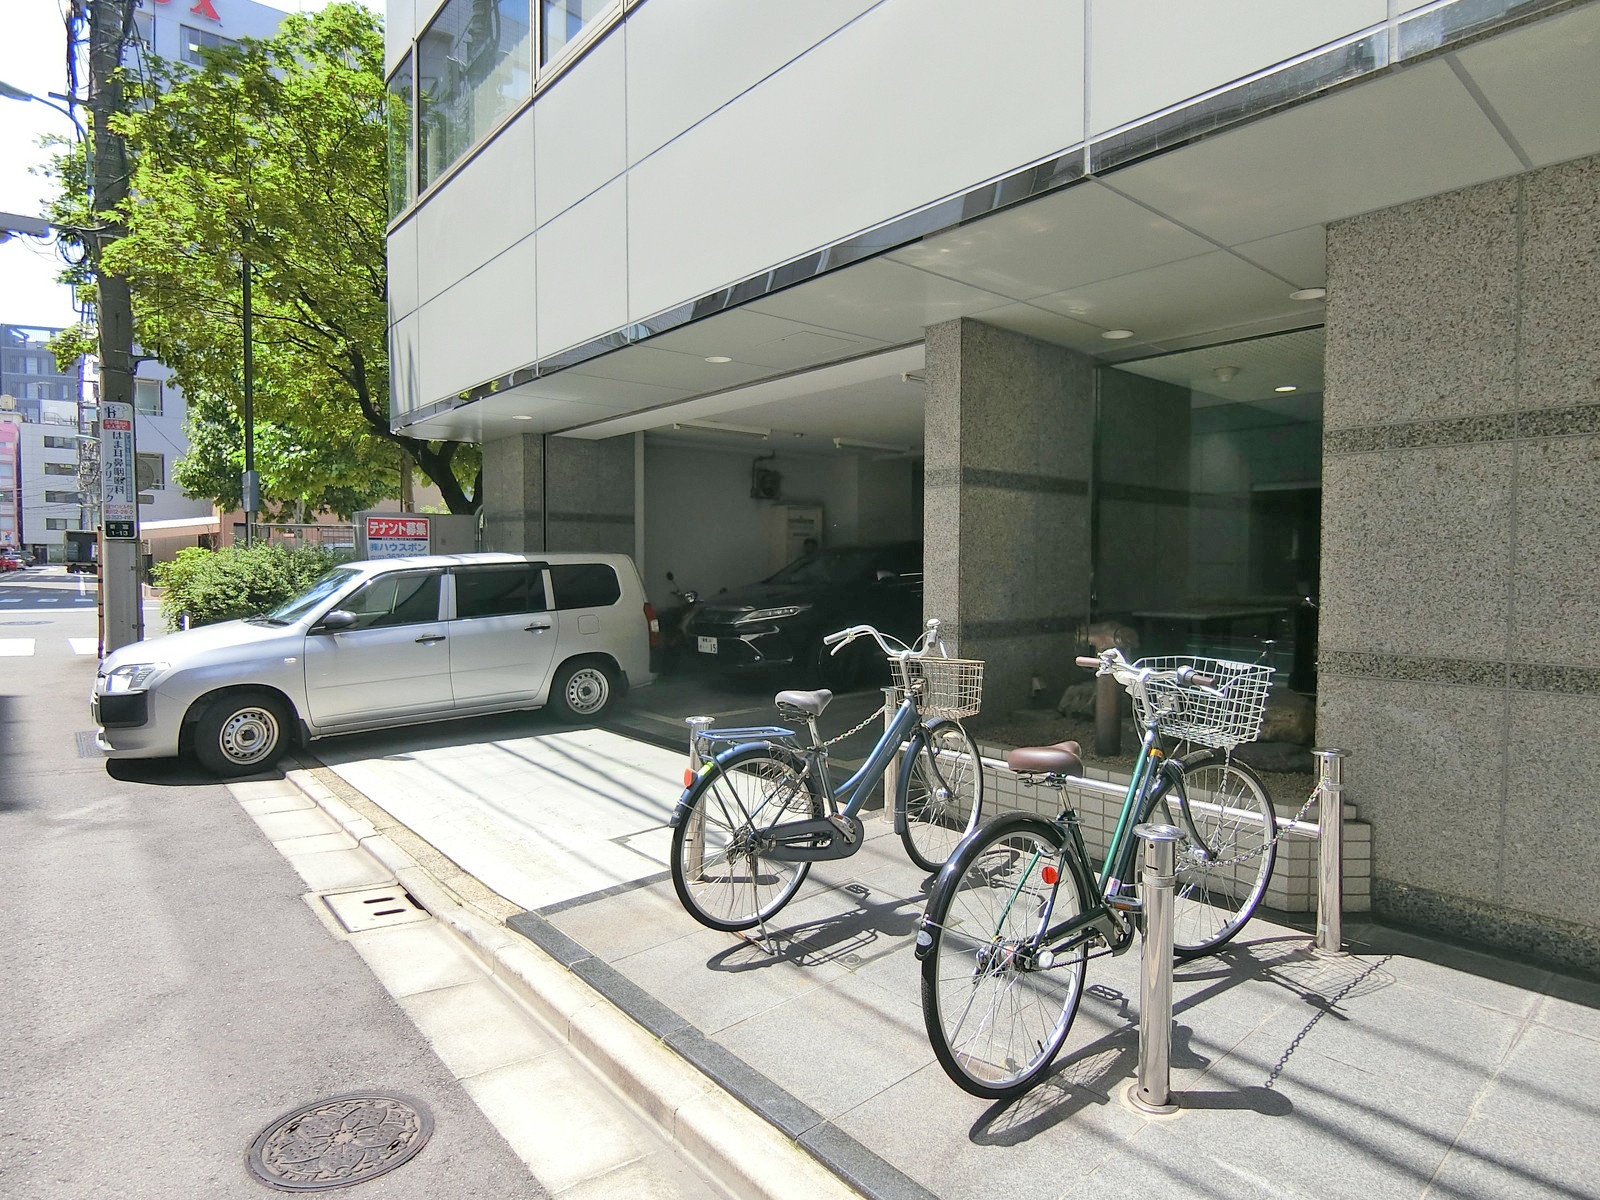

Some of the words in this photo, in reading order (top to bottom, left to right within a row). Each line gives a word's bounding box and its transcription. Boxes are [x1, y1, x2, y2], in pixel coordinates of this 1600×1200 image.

[105, 461, 114, 503] クリニック
[112, 431, 125, 494] はま耳鼻咽喉科
[370, 522, 427, 535] テナント募集
